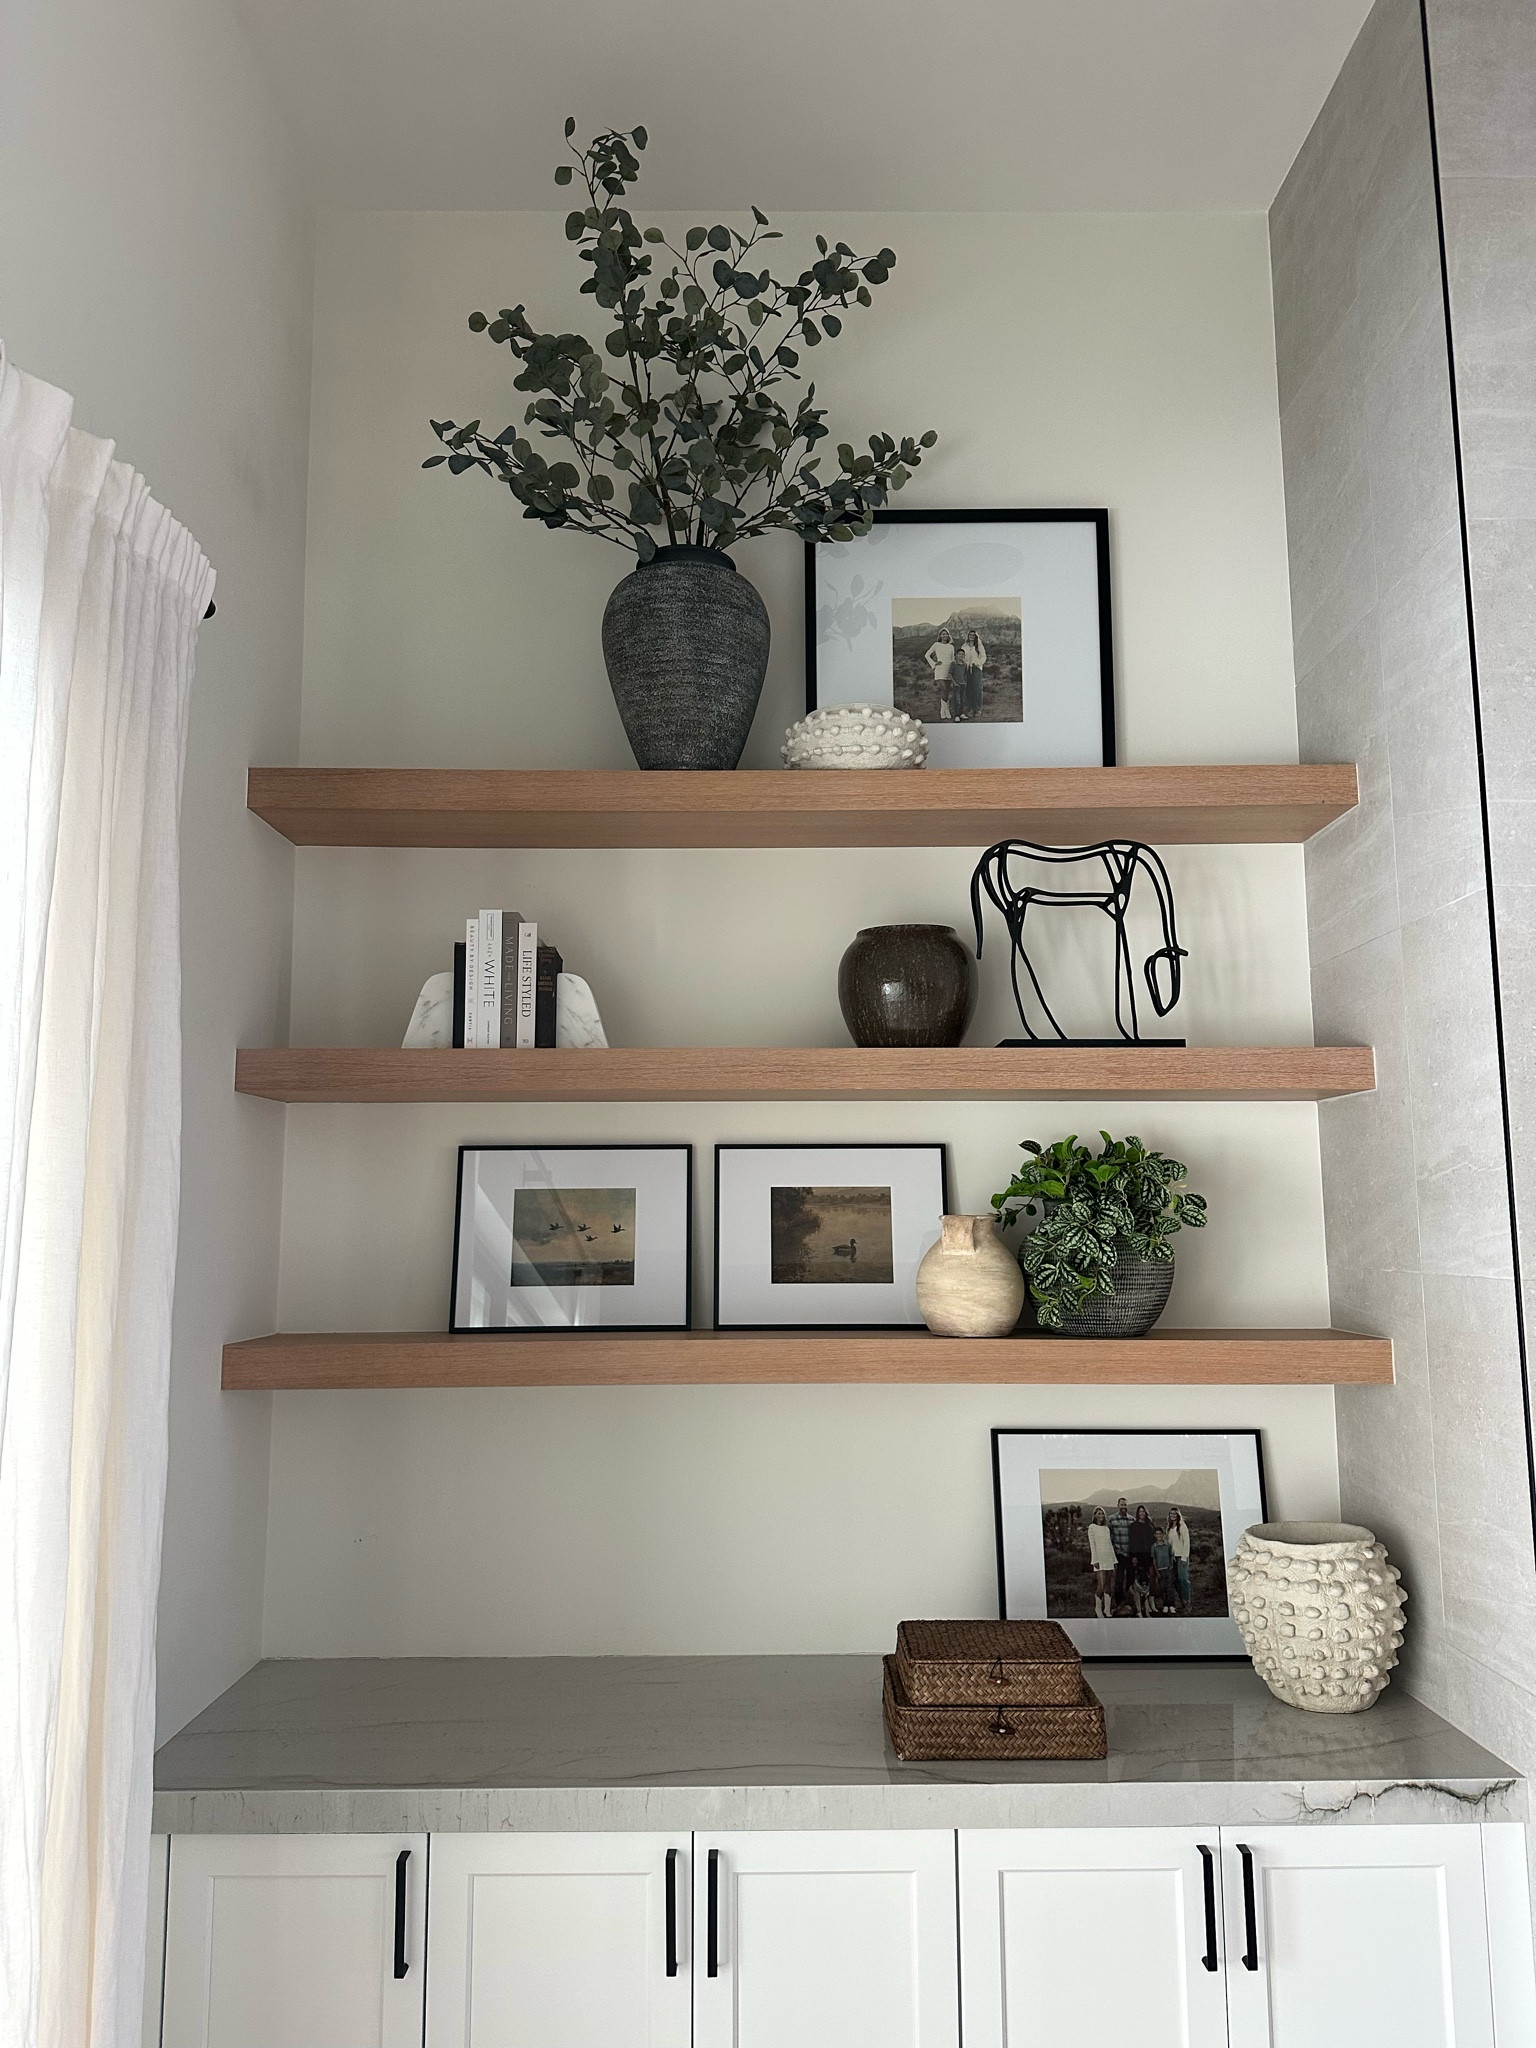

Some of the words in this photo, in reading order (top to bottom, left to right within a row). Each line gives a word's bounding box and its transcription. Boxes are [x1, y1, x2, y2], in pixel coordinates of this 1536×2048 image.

[469, 954, 475, 962] BY
[504, 936, 514, 970] MADE
[522, 950, 532, 974] LIFE
[483, 959, 495, 1007] WHITE
[521, 976, 532, 1018] STYLED
[503, 982, 513, 1025] LIVING
